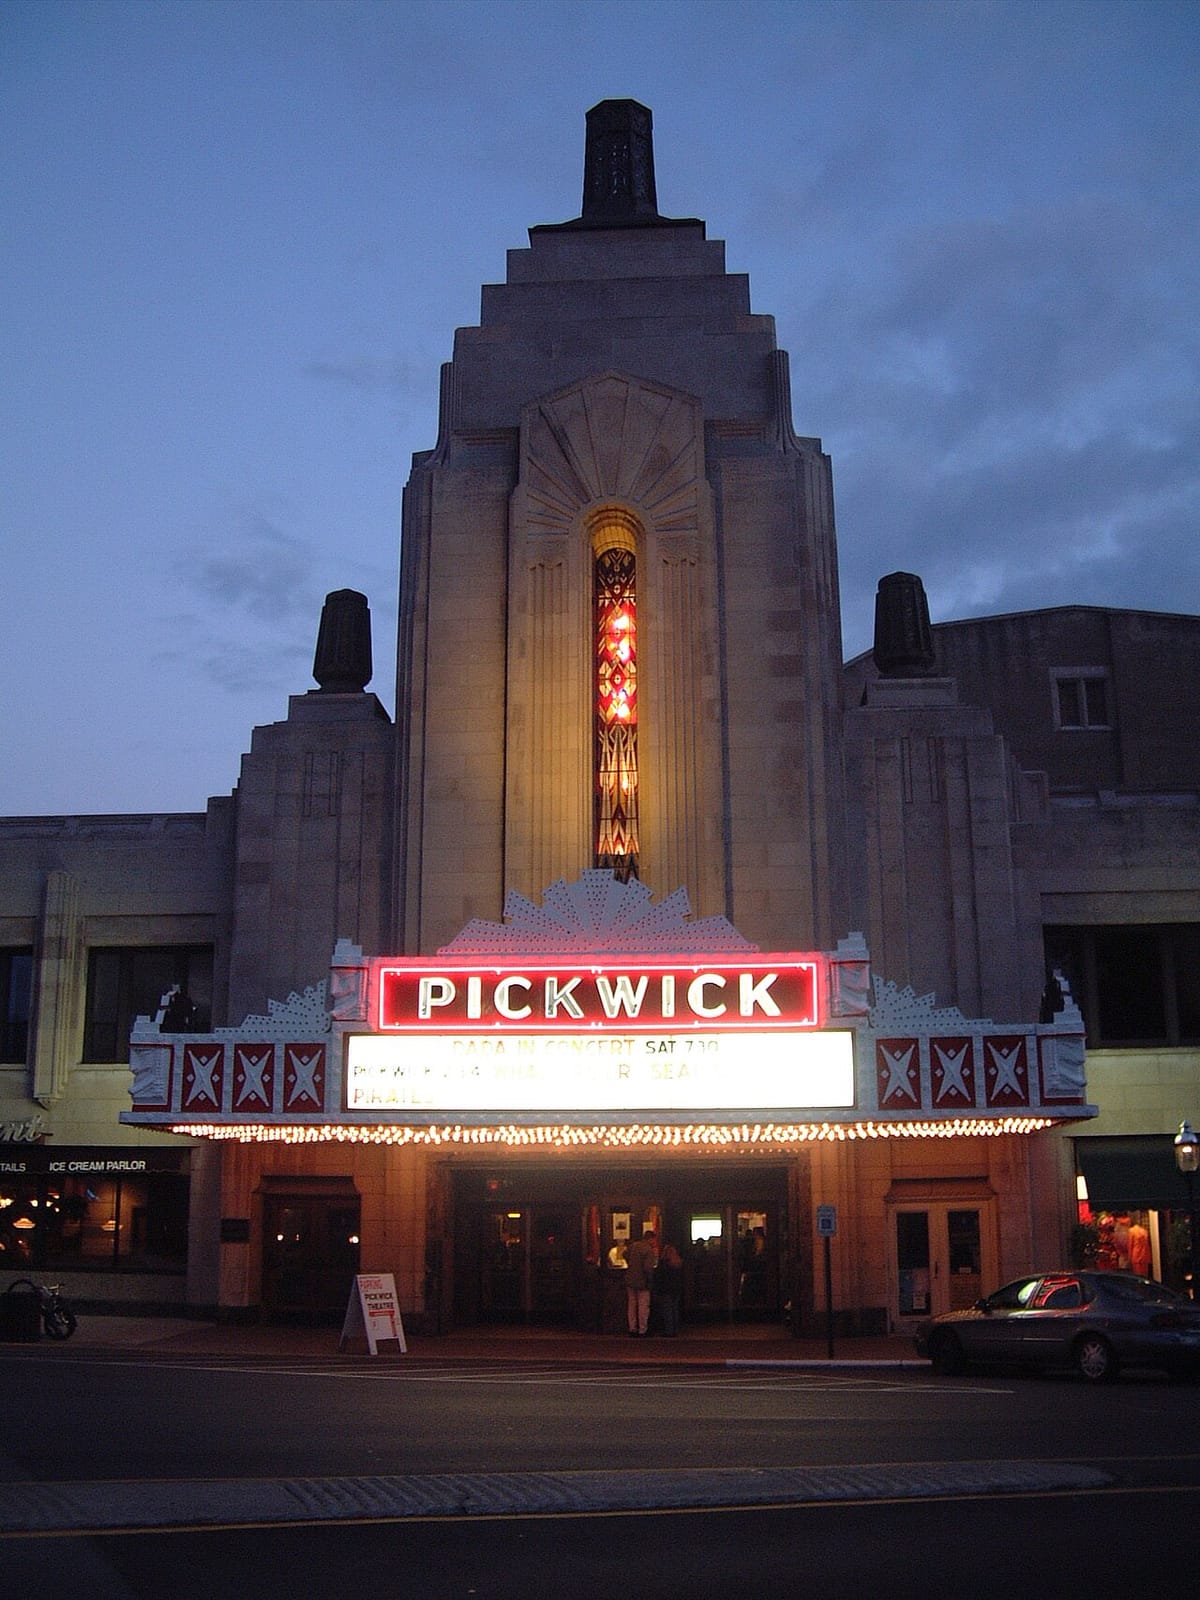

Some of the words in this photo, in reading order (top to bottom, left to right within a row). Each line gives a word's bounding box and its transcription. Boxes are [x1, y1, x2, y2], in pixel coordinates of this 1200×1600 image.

[418, 973, 782, 1020] PICKWICK
[545, 1038, 636, 1056] CONCERT
[645, 1040, 677, 1055] SAT
[49, 1161, 67, 1172] ICE
[68, 1161, 104, 1171] CREAM
[106, 1160, 146, 1170] PARLOR
